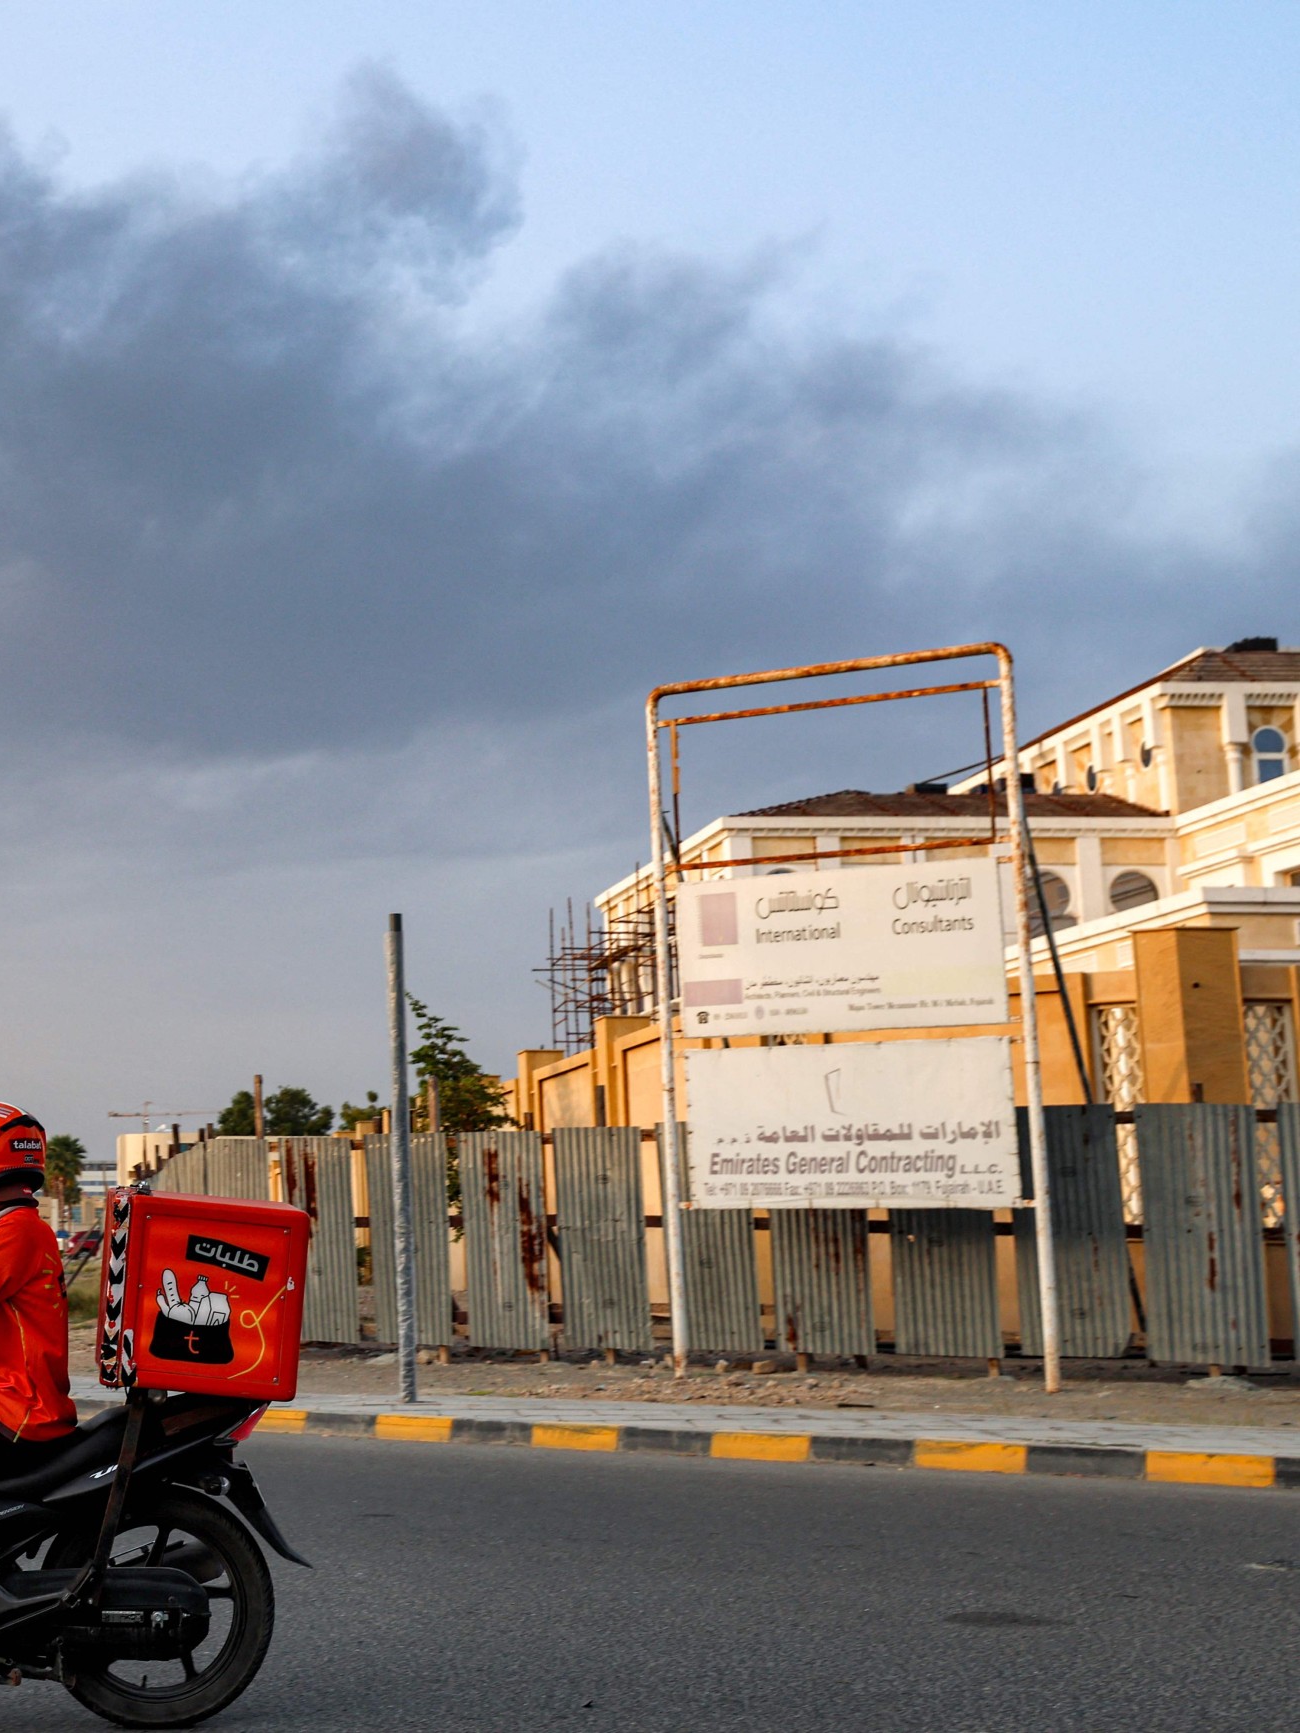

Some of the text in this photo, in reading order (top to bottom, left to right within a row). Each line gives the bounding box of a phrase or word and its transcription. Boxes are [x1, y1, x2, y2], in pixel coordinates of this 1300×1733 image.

[755, 914, 974, 944] International Consultants
[757, 1124, 816, 1144] العامة
[821, 1122, 913, 1146] للمقاولات
[919, 1120, 1001, 1145] الإمارات
[709, 1149, 1004, 1179] Emirates General Contracting L.L.C.
[194, 1242, 260, 1273] طلبات
